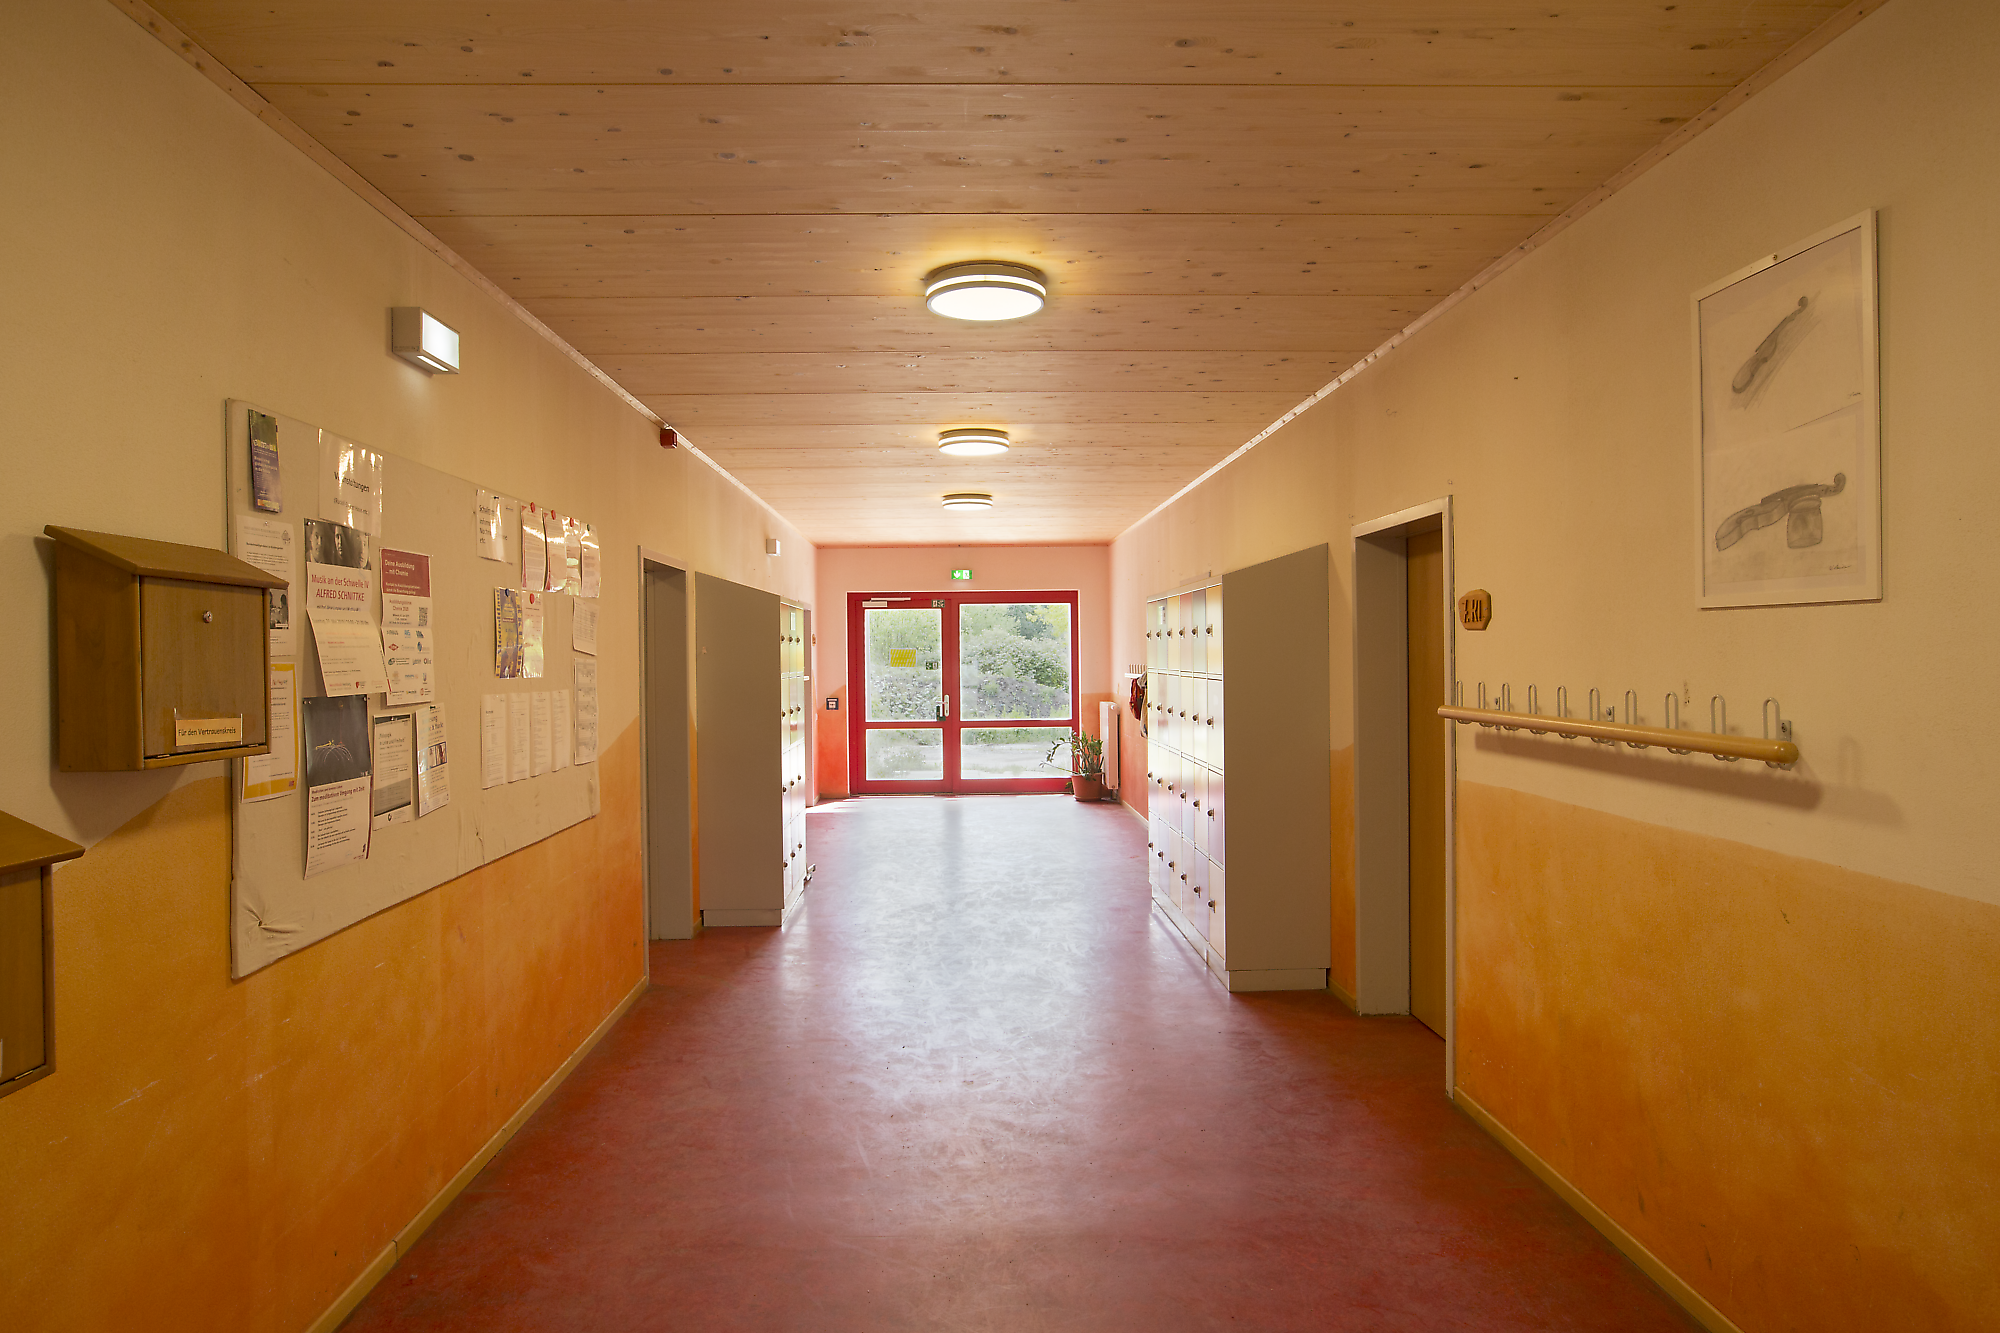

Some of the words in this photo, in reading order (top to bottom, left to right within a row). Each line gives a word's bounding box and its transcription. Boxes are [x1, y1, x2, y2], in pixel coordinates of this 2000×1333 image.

[311, 574, 327, 584] Musik
[335, 577, 343, 585] der
[343, 578, 364, 588] Schwelle
[364, 580, 370, 588] IV
[315, 589, 337, 598] ALFRED
[337, 590, 364, 601] SCHNITTKE
[188, 728, 197, 736] den
[198, 727, 236, 735] Vertrauenskreis
